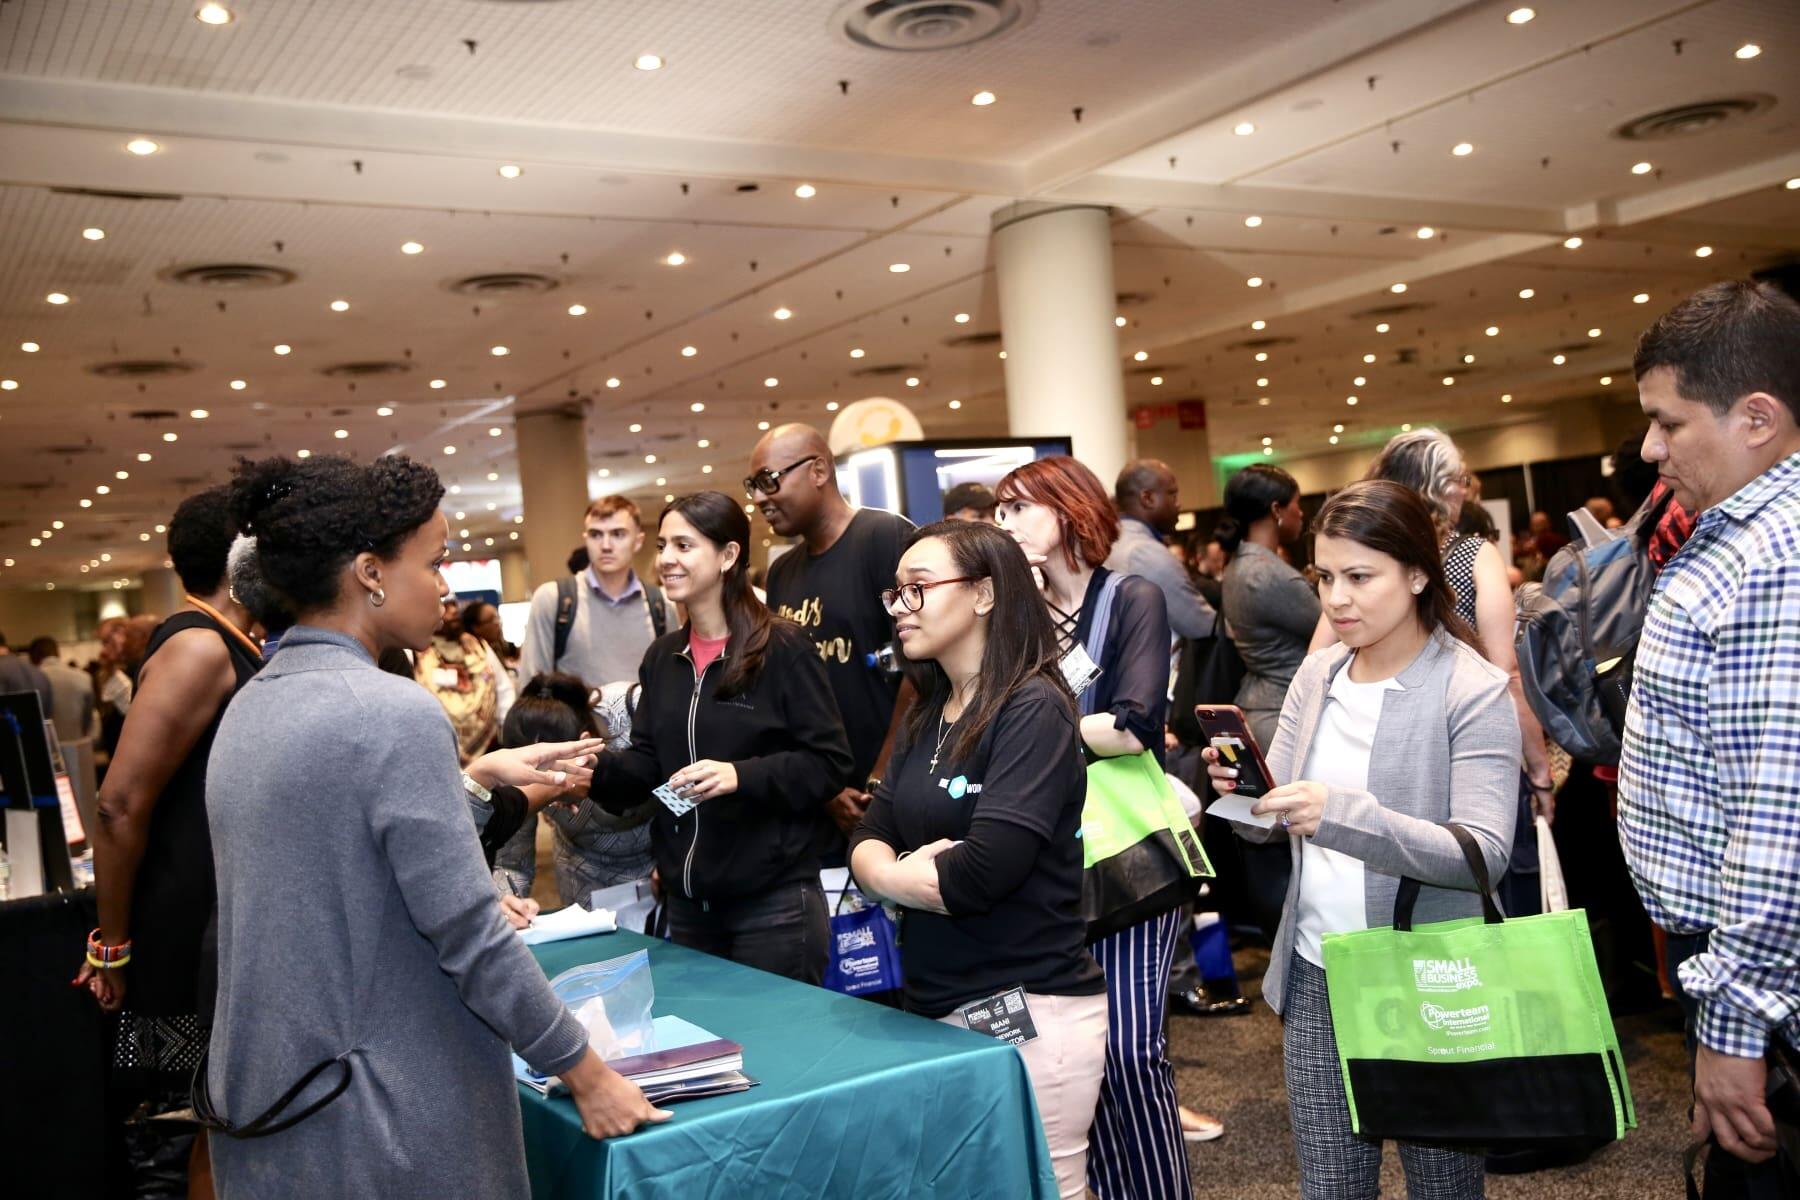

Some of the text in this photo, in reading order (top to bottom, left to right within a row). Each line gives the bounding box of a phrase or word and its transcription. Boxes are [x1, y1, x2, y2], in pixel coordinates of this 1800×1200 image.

[1425, 957, 1472, 974] SMALL
[1426, 966, 1478, 984] BUSINESS
[1428, 1004, 1489, 1020] Powerteam
[990, 1017, 1011, 1031] IMANI
[1428, 1041, 1495, 1056] Sprout Financial
